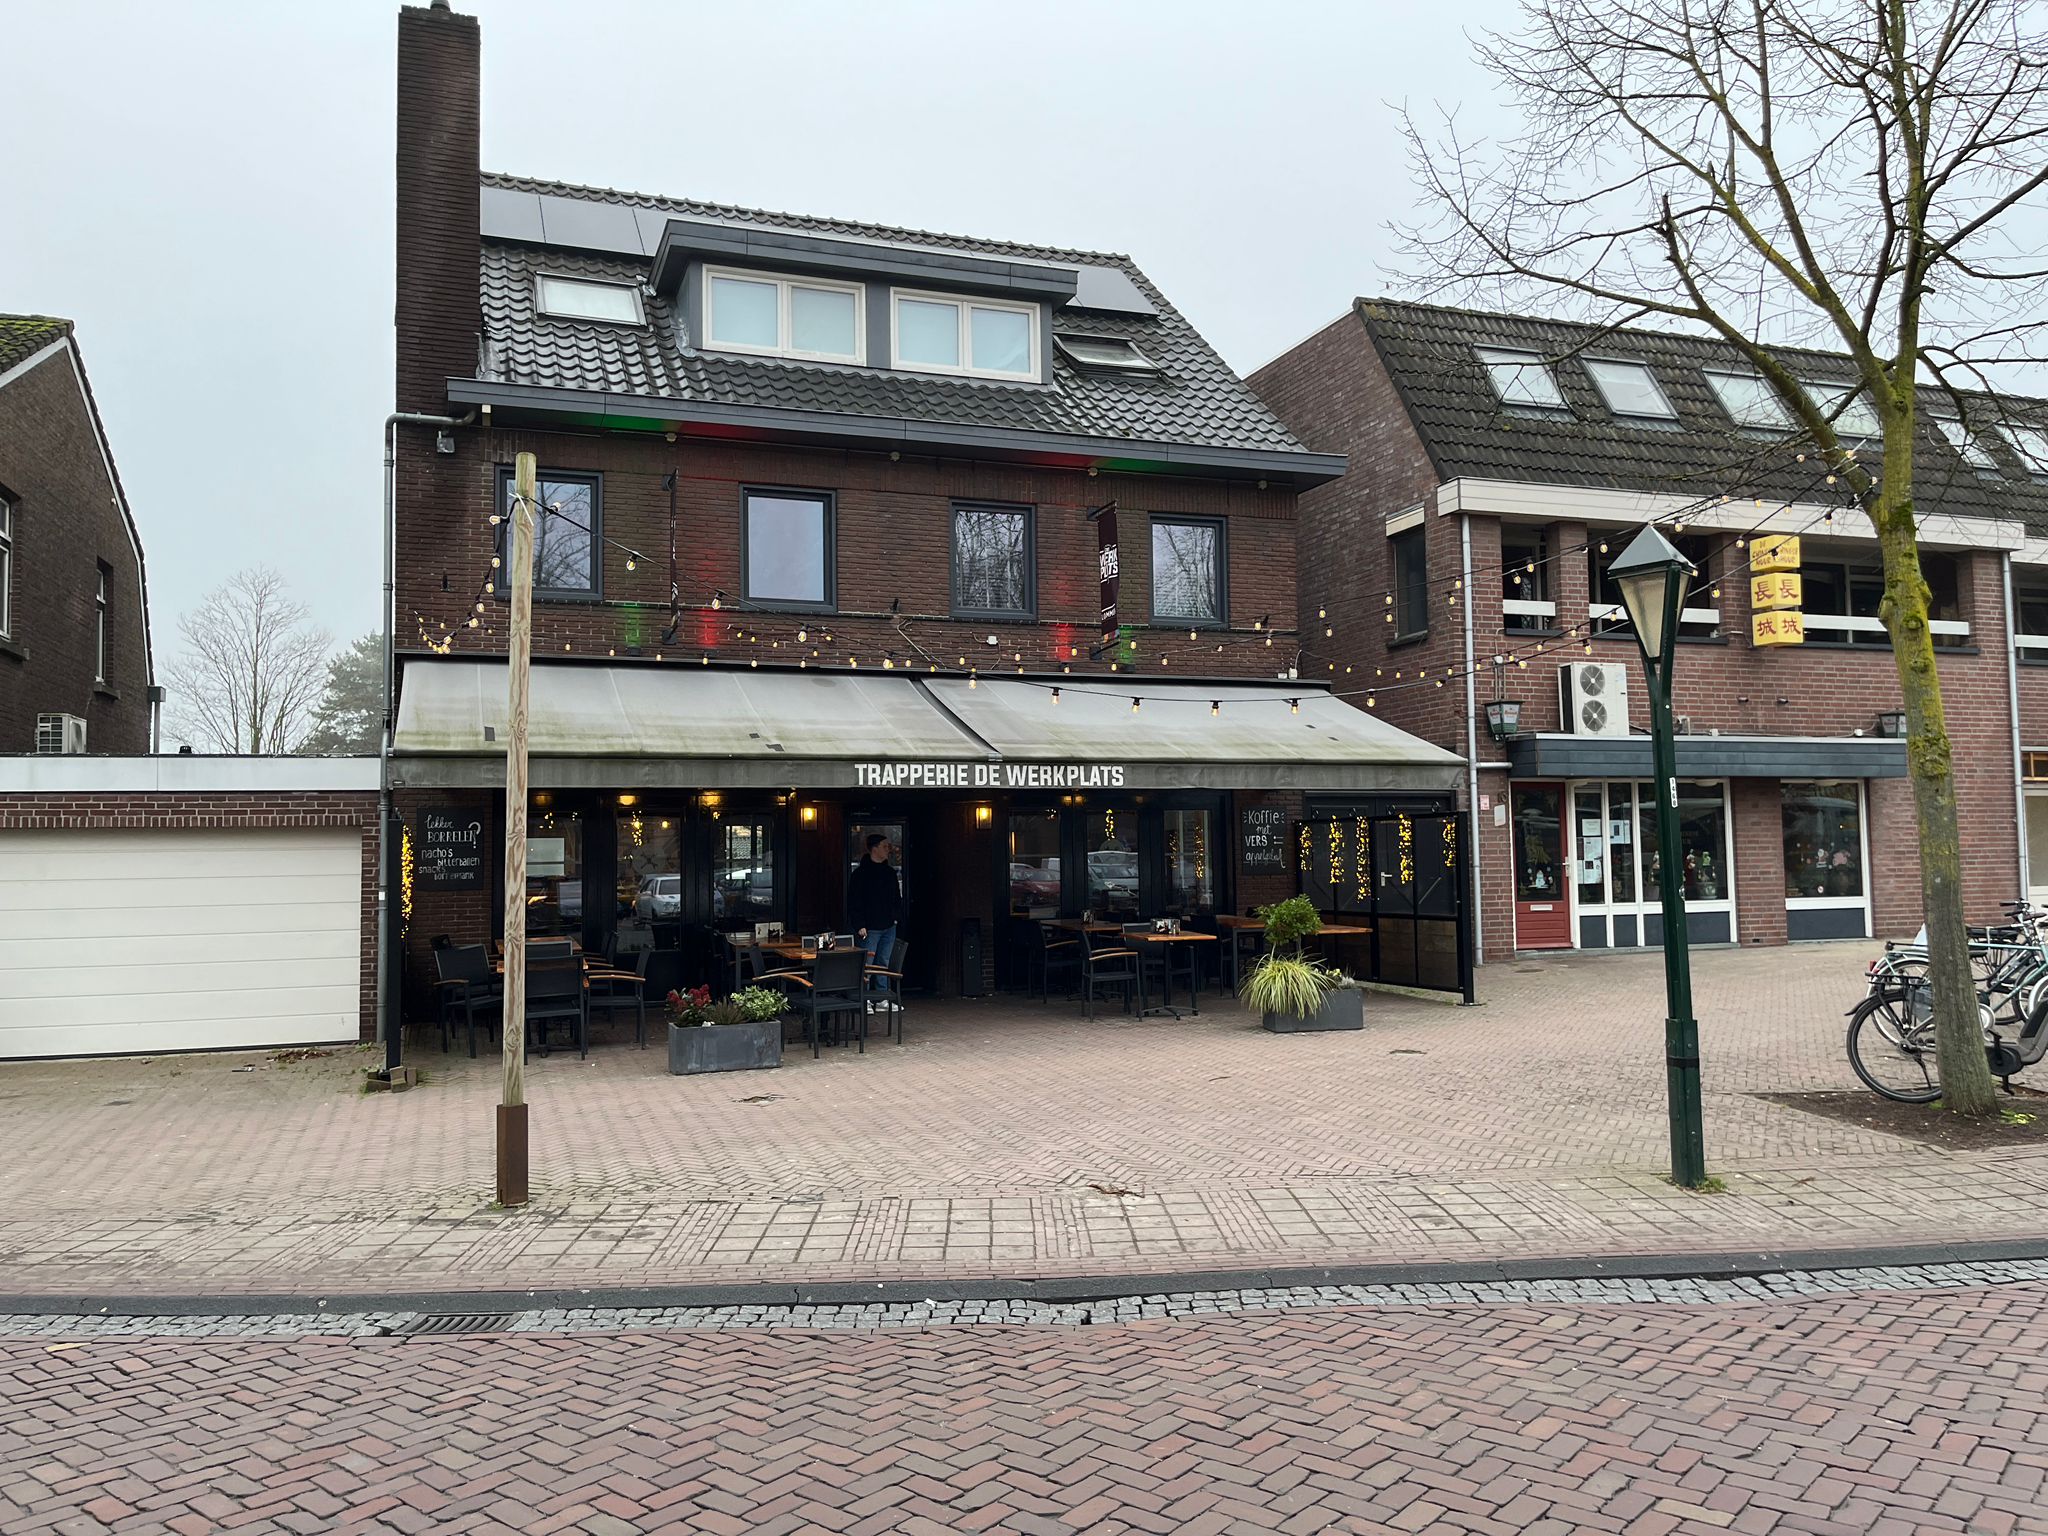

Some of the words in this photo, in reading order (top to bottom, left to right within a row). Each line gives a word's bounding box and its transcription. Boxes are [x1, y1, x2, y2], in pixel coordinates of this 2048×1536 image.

[854, 763, 968, 787] TRAPPERIE
[975, 763, 1001, 787] DE
[1005, 764, 1124, 787] WERKPLATS
[1255, 824, 1272, 835] met
[1244, 835, 1268, 847] VERS
